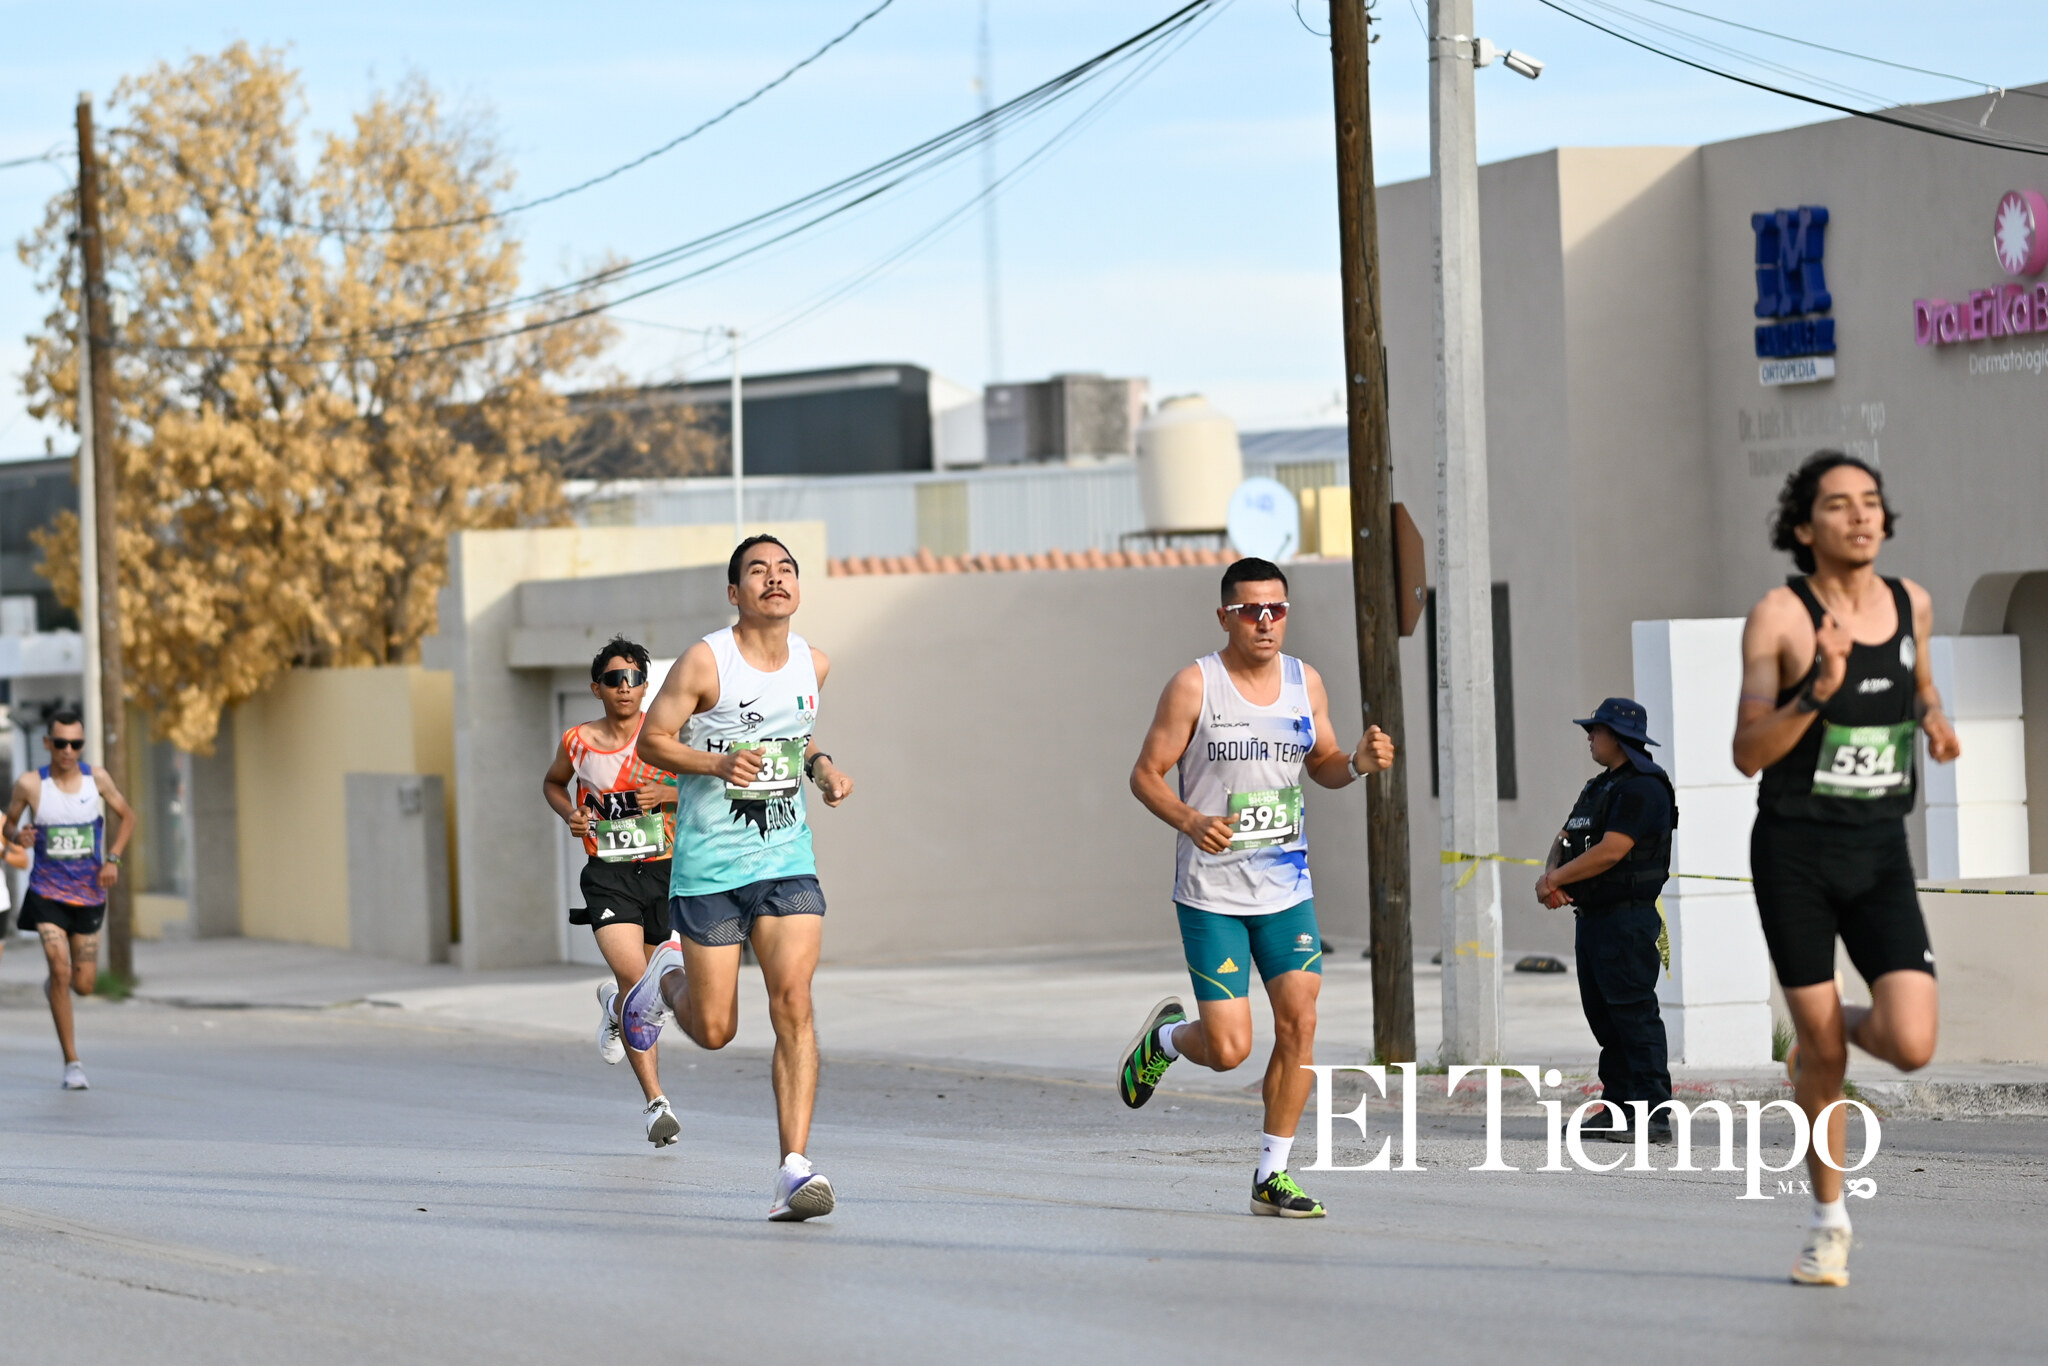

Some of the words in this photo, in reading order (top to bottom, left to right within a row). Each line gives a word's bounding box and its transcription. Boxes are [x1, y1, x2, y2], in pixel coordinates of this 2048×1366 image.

[1969, 284, 2031, 340] Erika
[1761, 358, 1817, 382] ORTOPEDIA
[1207, 737, 1269, 762] ORDUÑA
[1274, 742, 1306, 763] TEAM
[1831, 744, 1896, 776] 534
[757, 756, 789, 782] 35
[1239, 803, 1287, 832] 595
[52, 835, 85, 849] 287
[606, 829, 647, 849] 190
